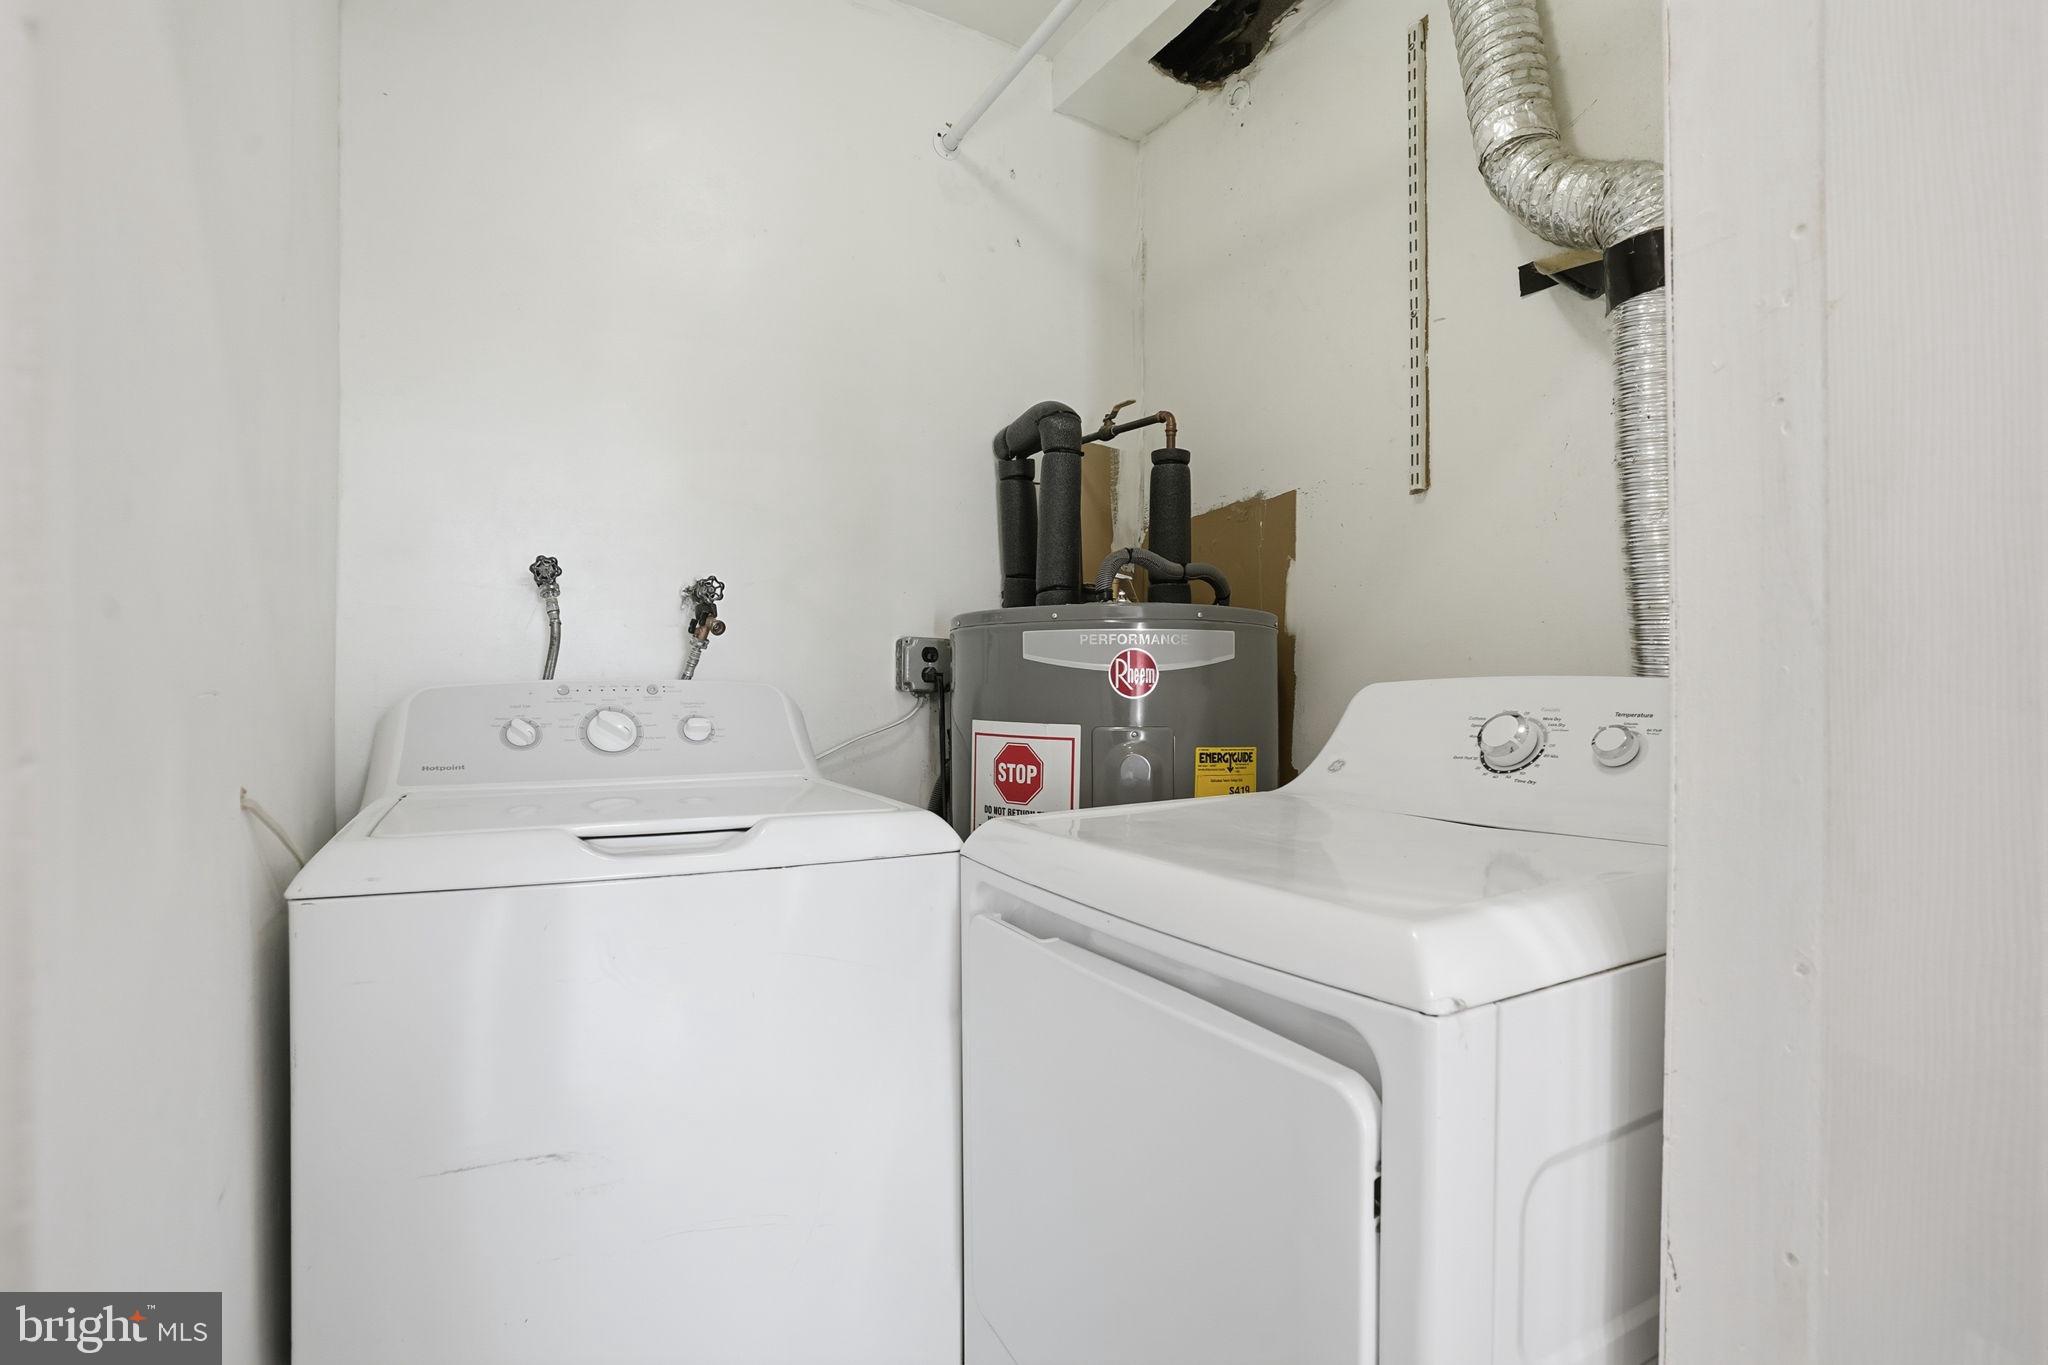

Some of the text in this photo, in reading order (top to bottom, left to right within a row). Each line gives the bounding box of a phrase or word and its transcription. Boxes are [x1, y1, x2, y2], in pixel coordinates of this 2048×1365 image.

[1079, 633, 1190, 645] PERFORMANCE
[1115, 651, 1155, 690] Rheem
[1615, 711, 1654, 719] Temperature
[1199, 751, 1254, 764] ENERGYGUIDE
[421, 764, 465, 772] Hotpoint
[998, 762, 1037, 784] STOP
[984, 804, 992, 814] DO
[993, 806, 1006, 816] NOT
